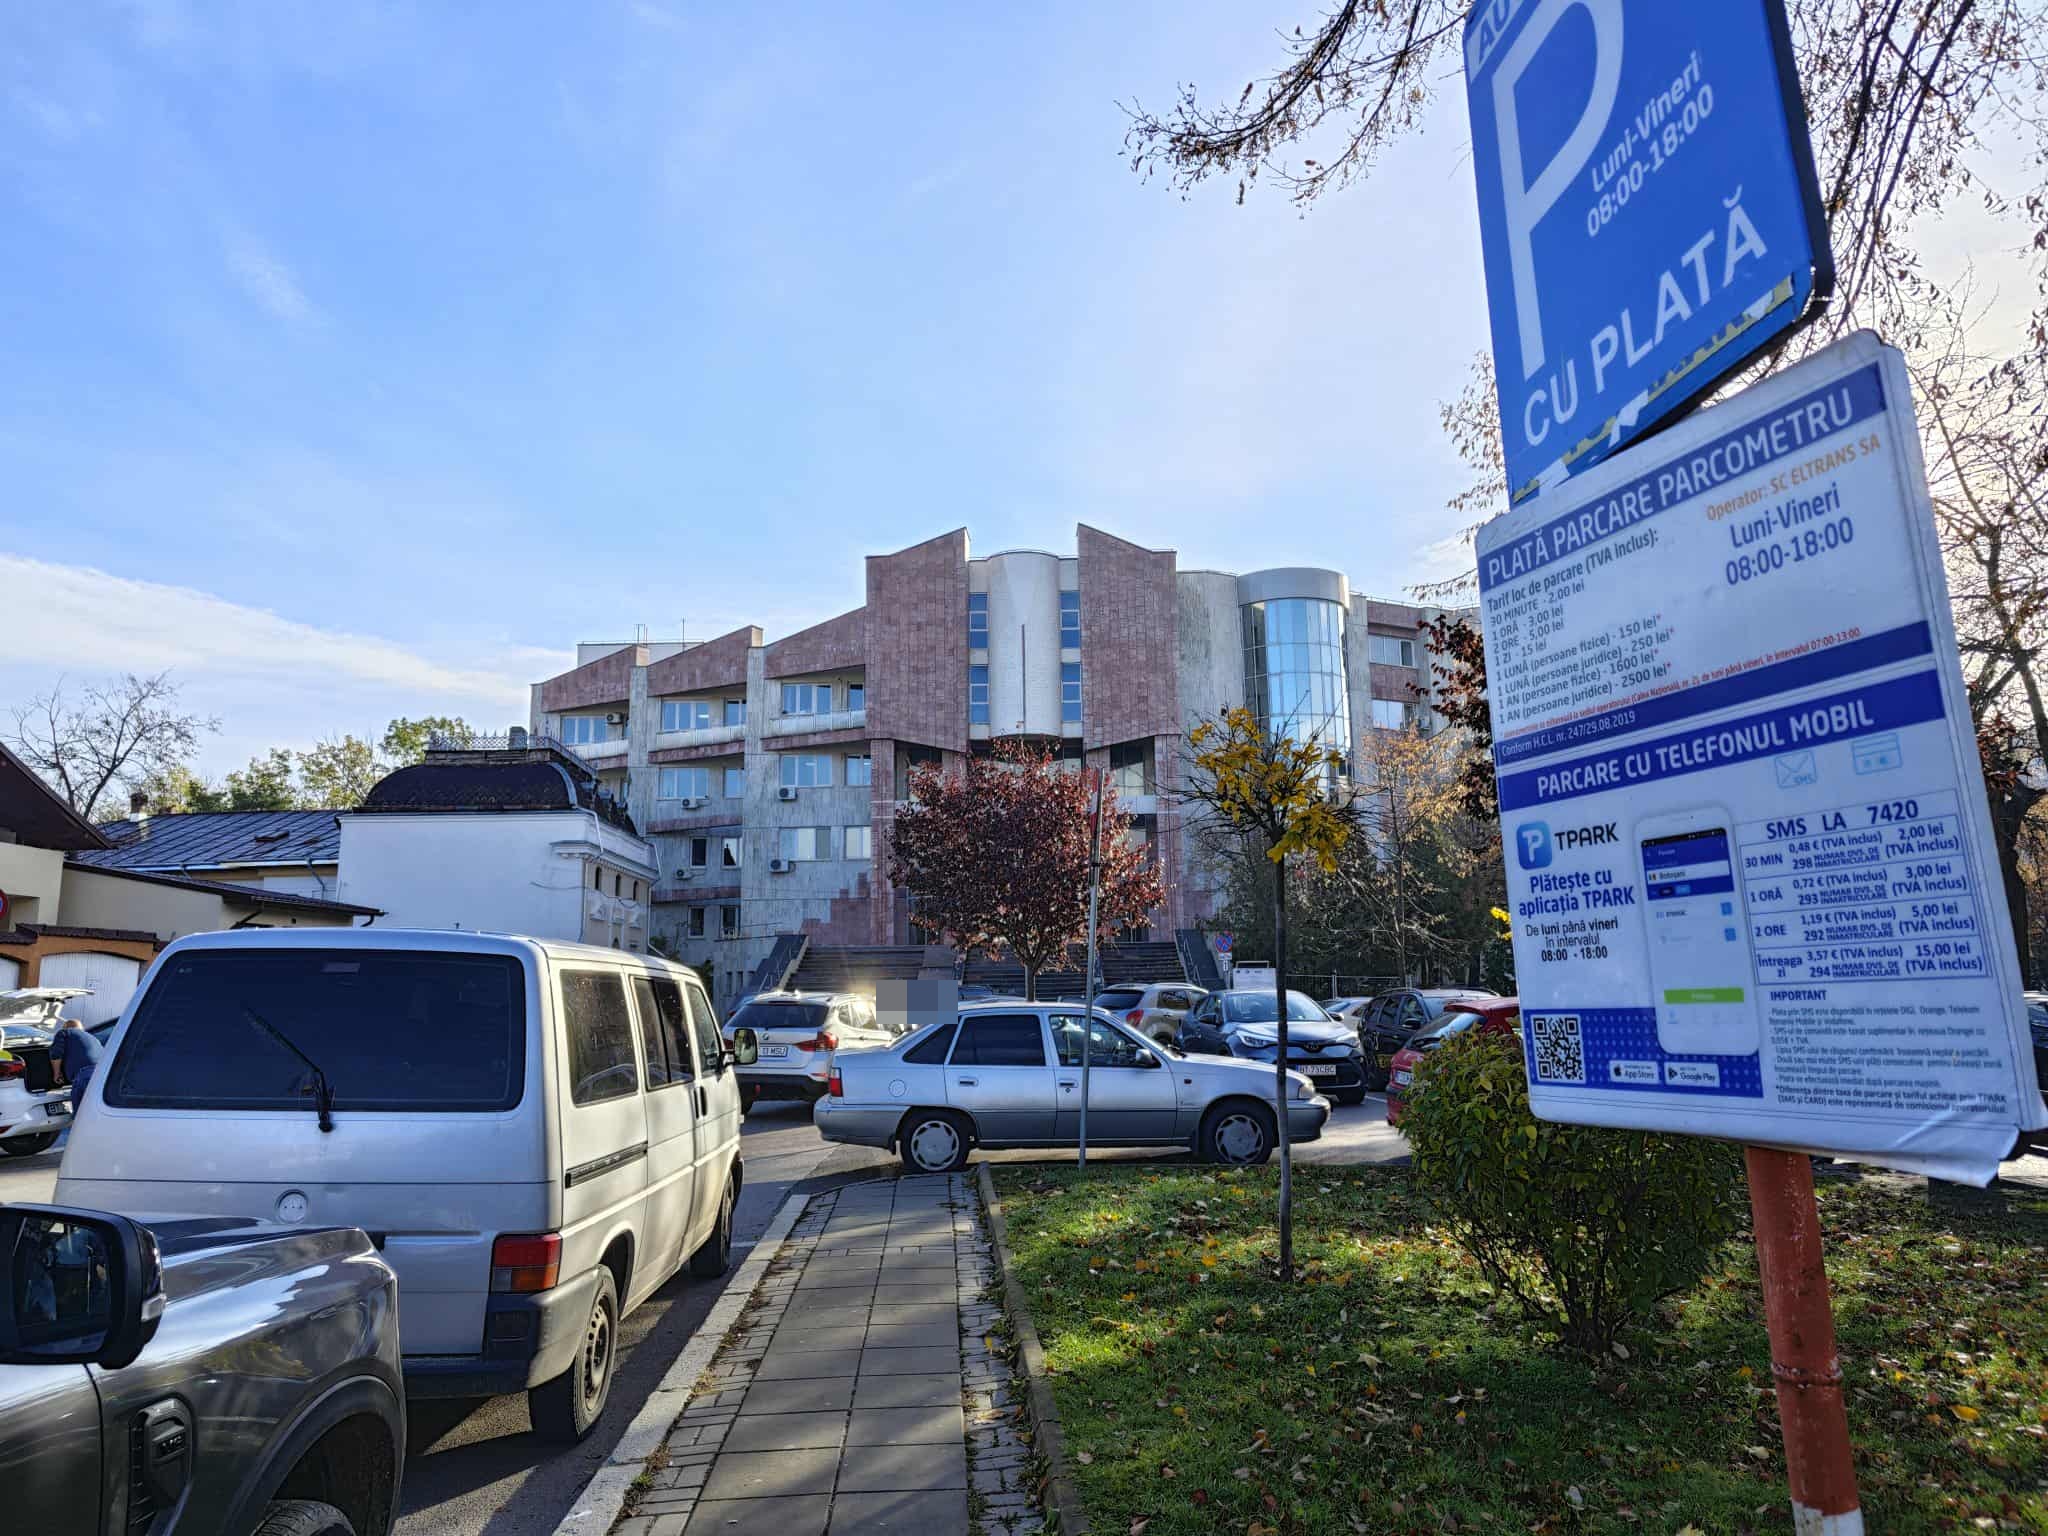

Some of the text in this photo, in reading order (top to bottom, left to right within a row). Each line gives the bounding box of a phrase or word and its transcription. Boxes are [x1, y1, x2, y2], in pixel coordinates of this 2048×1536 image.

[1592, 51, 1701, 192] Luni-Vineri
[1587, 84, 1713, 237] 08:00-18:00
[1524, 185, 1768, 446] CU PLATĂ
[1488, 388, 1853, 586] PLATĂ PARCARE PARCOMETRU
[1706, 433, 1880, 521] Operator: SC ELTRANS SA
[1730, 481, 1840, 549] Luni-Vineri
[1726, 517, 1853, 585] 08:00-18:00
[1488, 528, 1659, 612] Tarif loc de parcare (TVA inclus):
[1503, 599, 1538, 621] MINUTE
[1501, 635, 1520, 650] ORE
[1531, 647, 1578, 674] (persoane
[1580, 632, 1610, 654] fizice)
[1619, 621, 1641, 640] 150
[1532, 662, 1580, 689] (persoane
[1581, 645, 1624, 678] juridice)
[1632, 635, 1654, 653] 250
[1523, 678, 1569, 705] (persoane
[1570, 661, 1601, 686] fizice)
[1610, 654, 1639, 675] 1600
[1507, 706, 1525, 722] AN
[1524, 693, 1570, 719] (persoane
[1571, 678, 1613, 707] juridice)
[1622, 667, 1650, 689] 2500
[1501, 741, 1531, 757] Conform
[1567, 711, 1636, 741] 247/29.08.2019
[1537, 699, 1875, 798] PARCARE CU TELEFONUL MOBIL
[1766, 799, 1919, 840] SMS LA 7420
[1554, 822, 1618, 851] TPARK
[1789, 831, 1882, 854] 0,48 € (TVA inclus)
[1898, 823, 1944, 841] 2,00 lei
[1886, 835, 1960, 859] (TVA inclus)
[1746, 853, 1783, 868] 30 MIN
[1793, 857, 1813, 870] 298
[1905, 861, 1952, 880] 3,00 lei
[1530, 870, 1612, 894] Plătește cu
[1792, 868, 1888, 890] 0,72 € (TVA inclus)
[1892, 874, 1967, 897] (TVA inclus)
[1519, 885, 1636, 919] aplicația TPARK
[1760, 887, 1783, 901] ORĂ
[1798, 893, 1819, 905] 293
[1801, 905, 1896, 926] 1,19 € (TVA inclus)
[1912, 900, 1959, 919] 5,00 lei
[1526, 915, 1618, 937] De luni până vineri
[1764, 924, 1787, 937] ORE
[1804, 930, 1825, 941] 292
[1899, 915, 1975, 936] (TVA inclus)
[1557, 933, 1600, 948] intervalul
[1916, 941, 1971, 958] 15,00 lei
[1541, 946, 1608, 961] 08:00 18:00
[1808, 943, 1904, 962] 3,57 € (TVA inclus)
[1906, 953, 1983, 974] (TVA inclus)
[1810, 966, 1831, 978] 294
[1770, 990, 1827, 1001] IMPORTANT
